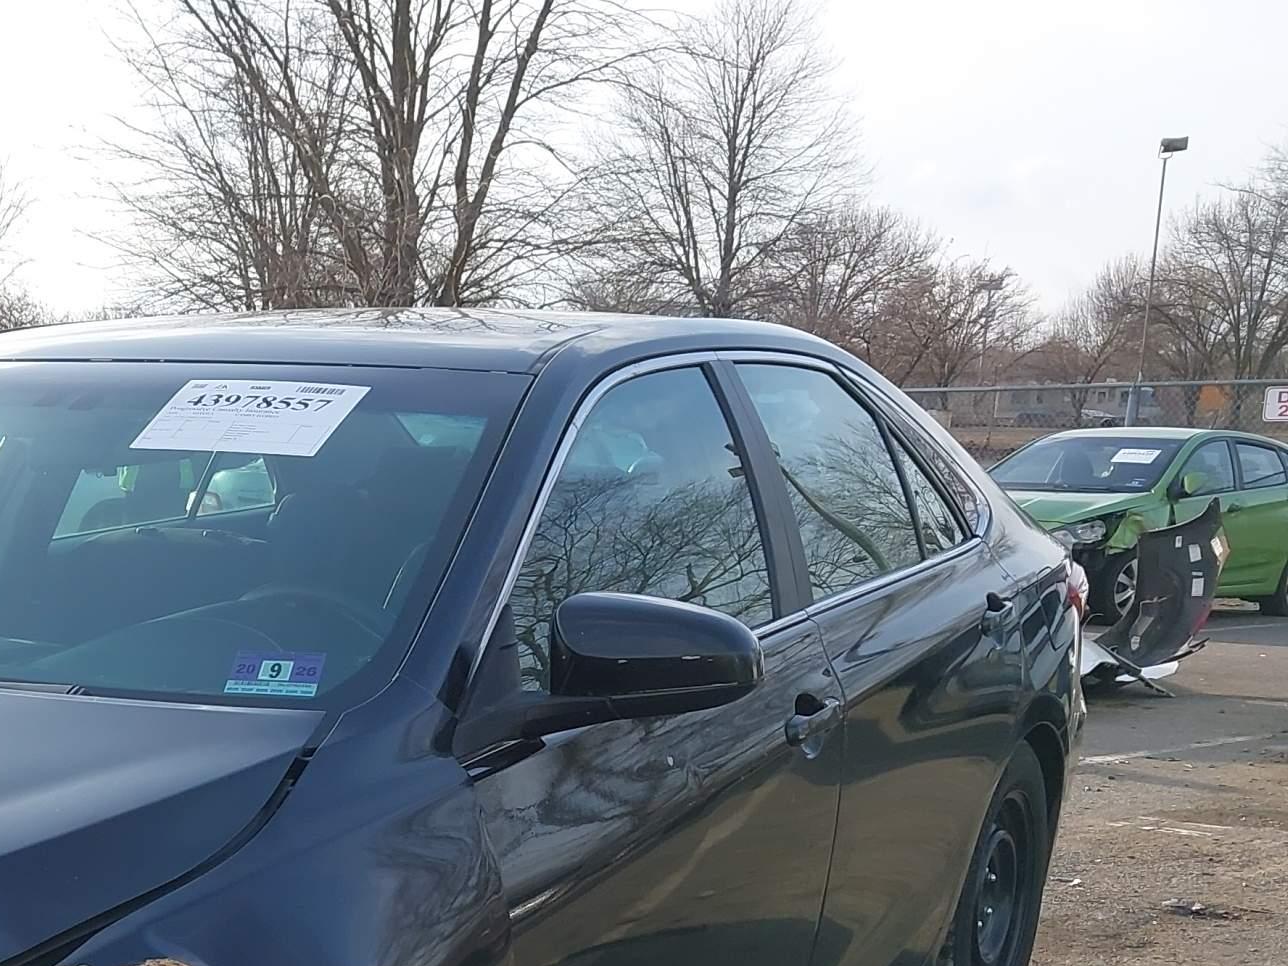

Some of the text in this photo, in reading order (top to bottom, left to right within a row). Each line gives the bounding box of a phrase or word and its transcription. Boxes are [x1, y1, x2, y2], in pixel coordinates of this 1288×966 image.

[187, 394, 333, 412] 43978557
[236, 663, 317, 678] 20 9 26
